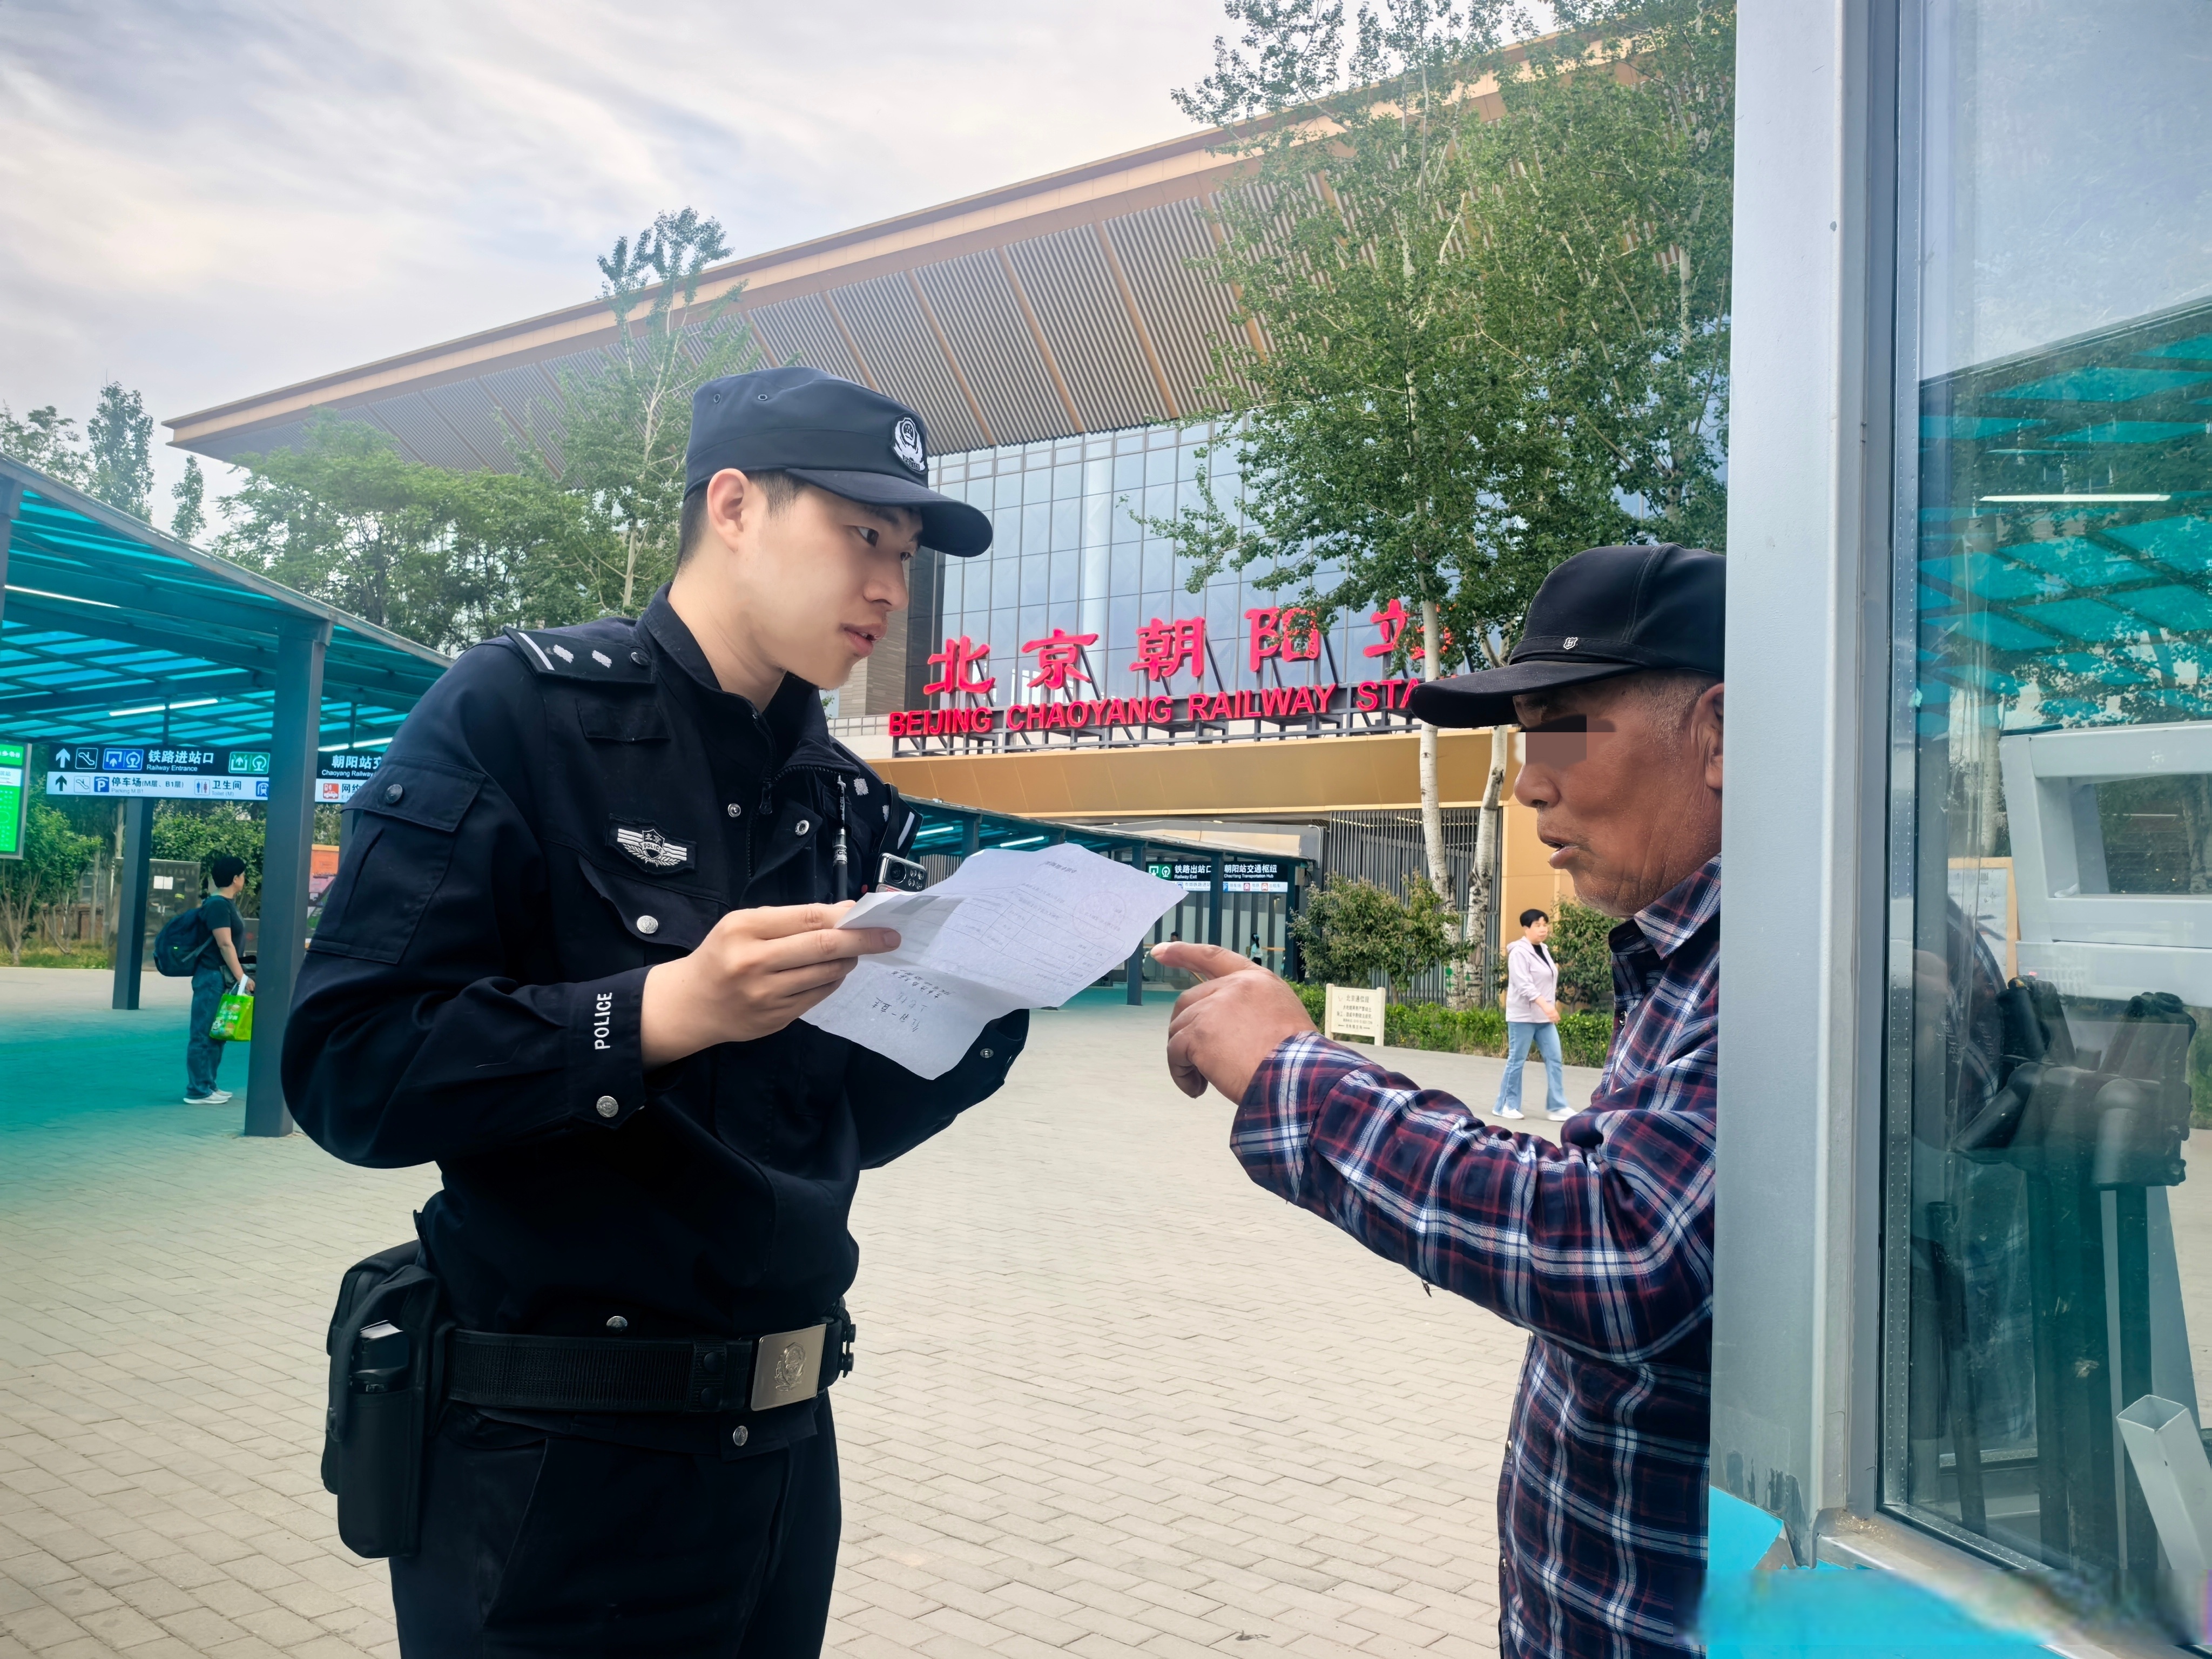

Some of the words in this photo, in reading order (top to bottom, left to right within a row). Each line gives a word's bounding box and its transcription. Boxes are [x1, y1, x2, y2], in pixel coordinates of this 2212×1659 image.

[903, 457, 920, 470] POLICE
[888, 706, 993, 737] BEIJING
[1006, 696, 1173, 731] CHAOYANG
[1188, 684, 1337, 721] RAILWAY
[148, 750, 214, 764] 铁路进站口
[146, 764, 170, 772] Railway
[212, 780, 241, 790] 卫生间
[645, 833, 662, 844] 北京
[644, 844, 662, 853] POLICE
[1174, 865, 1211, 874] 铁路出站口
[1224, 864, 1277, 873] 朝阳站交通枢纽
[594, 992, 613, 1050] POLICE
